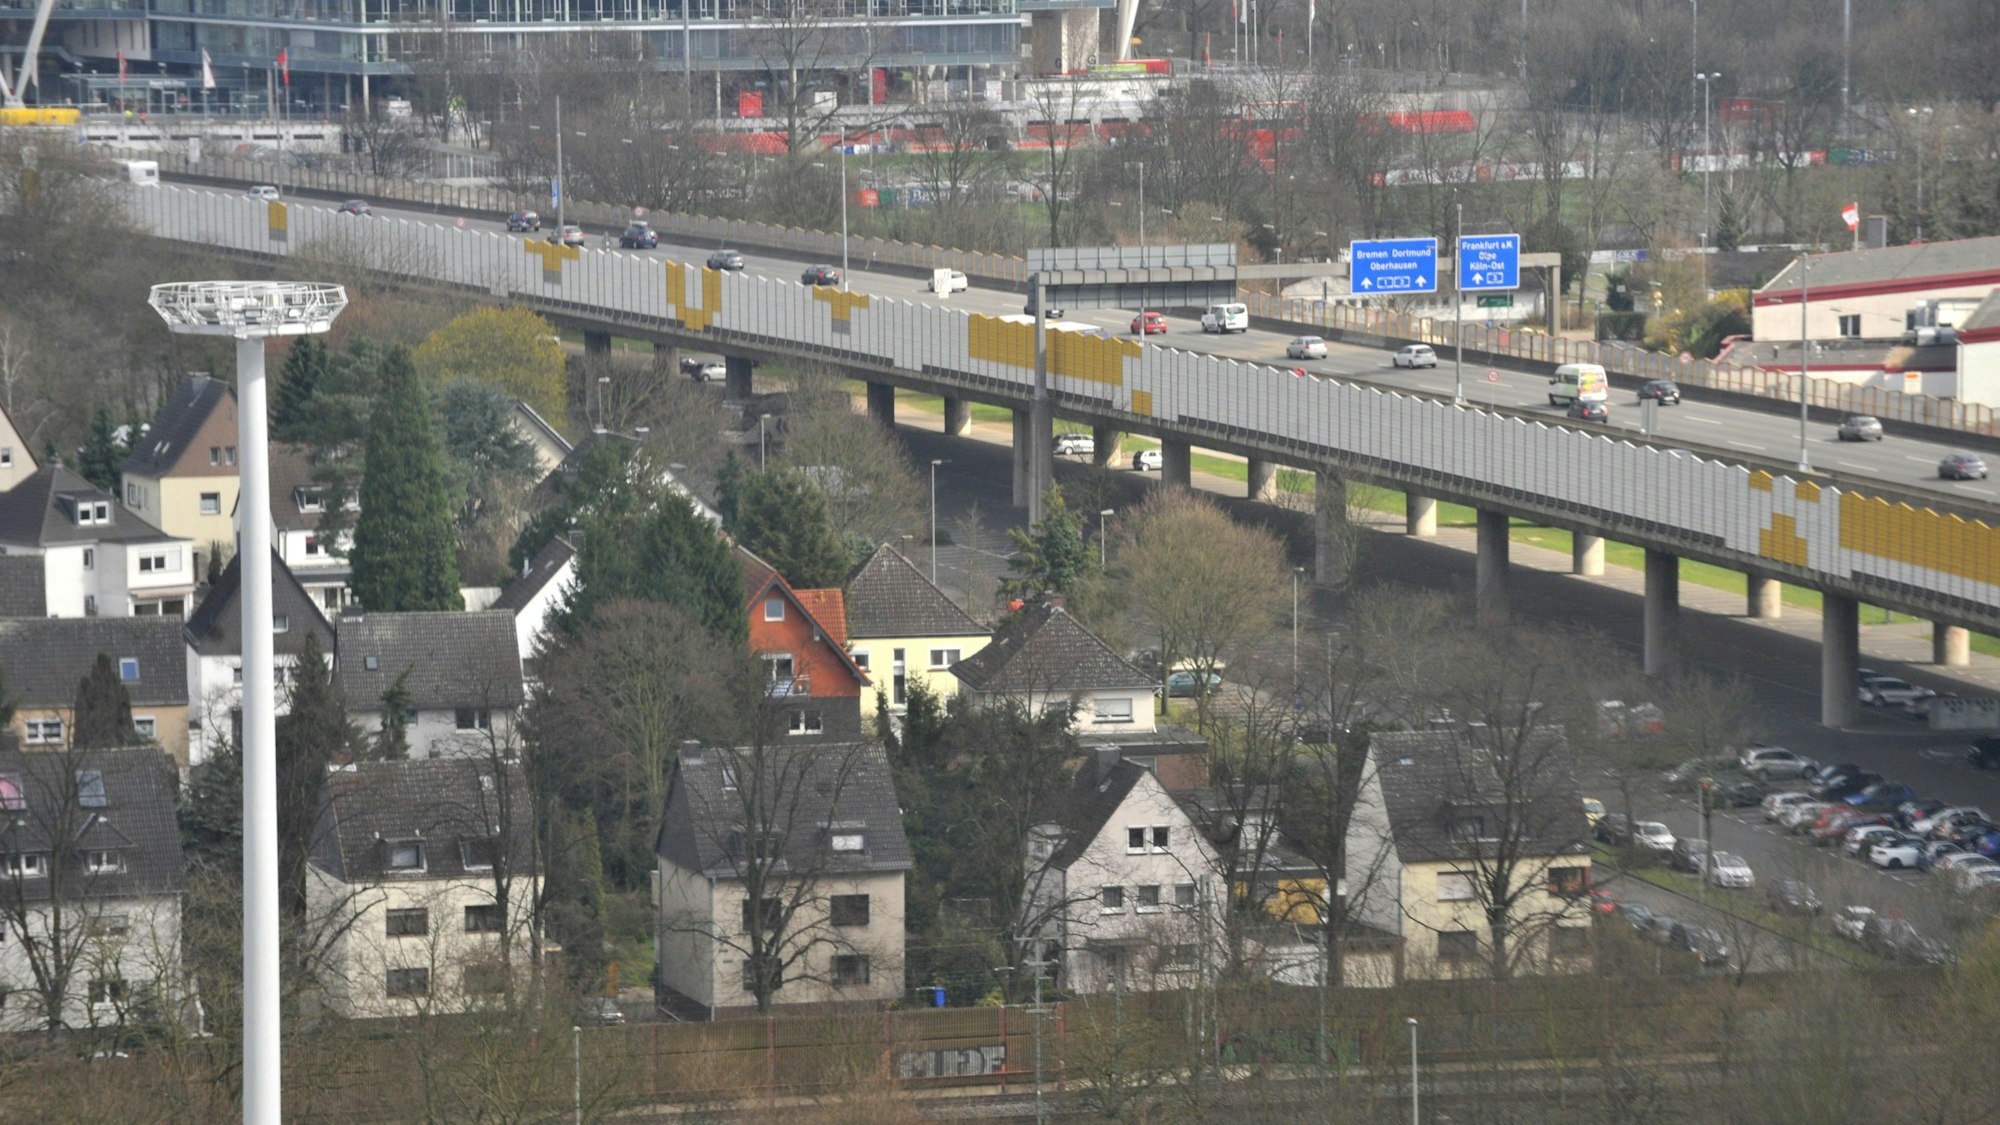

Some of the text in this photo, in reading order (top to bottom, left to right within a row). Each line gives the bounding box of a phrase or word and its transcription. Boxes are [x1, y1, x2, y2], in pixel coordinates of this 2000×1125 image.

[1462, 241, 1500, 250] Frankfurt
[1357, 248, 1431, 259] Bremen Dortmund
[1479, 251, 1497, 261] Olpe
[1370, 261, 1418, 270] Oberhausen
[1470, 261, 1505, 270] Köln-Ost
